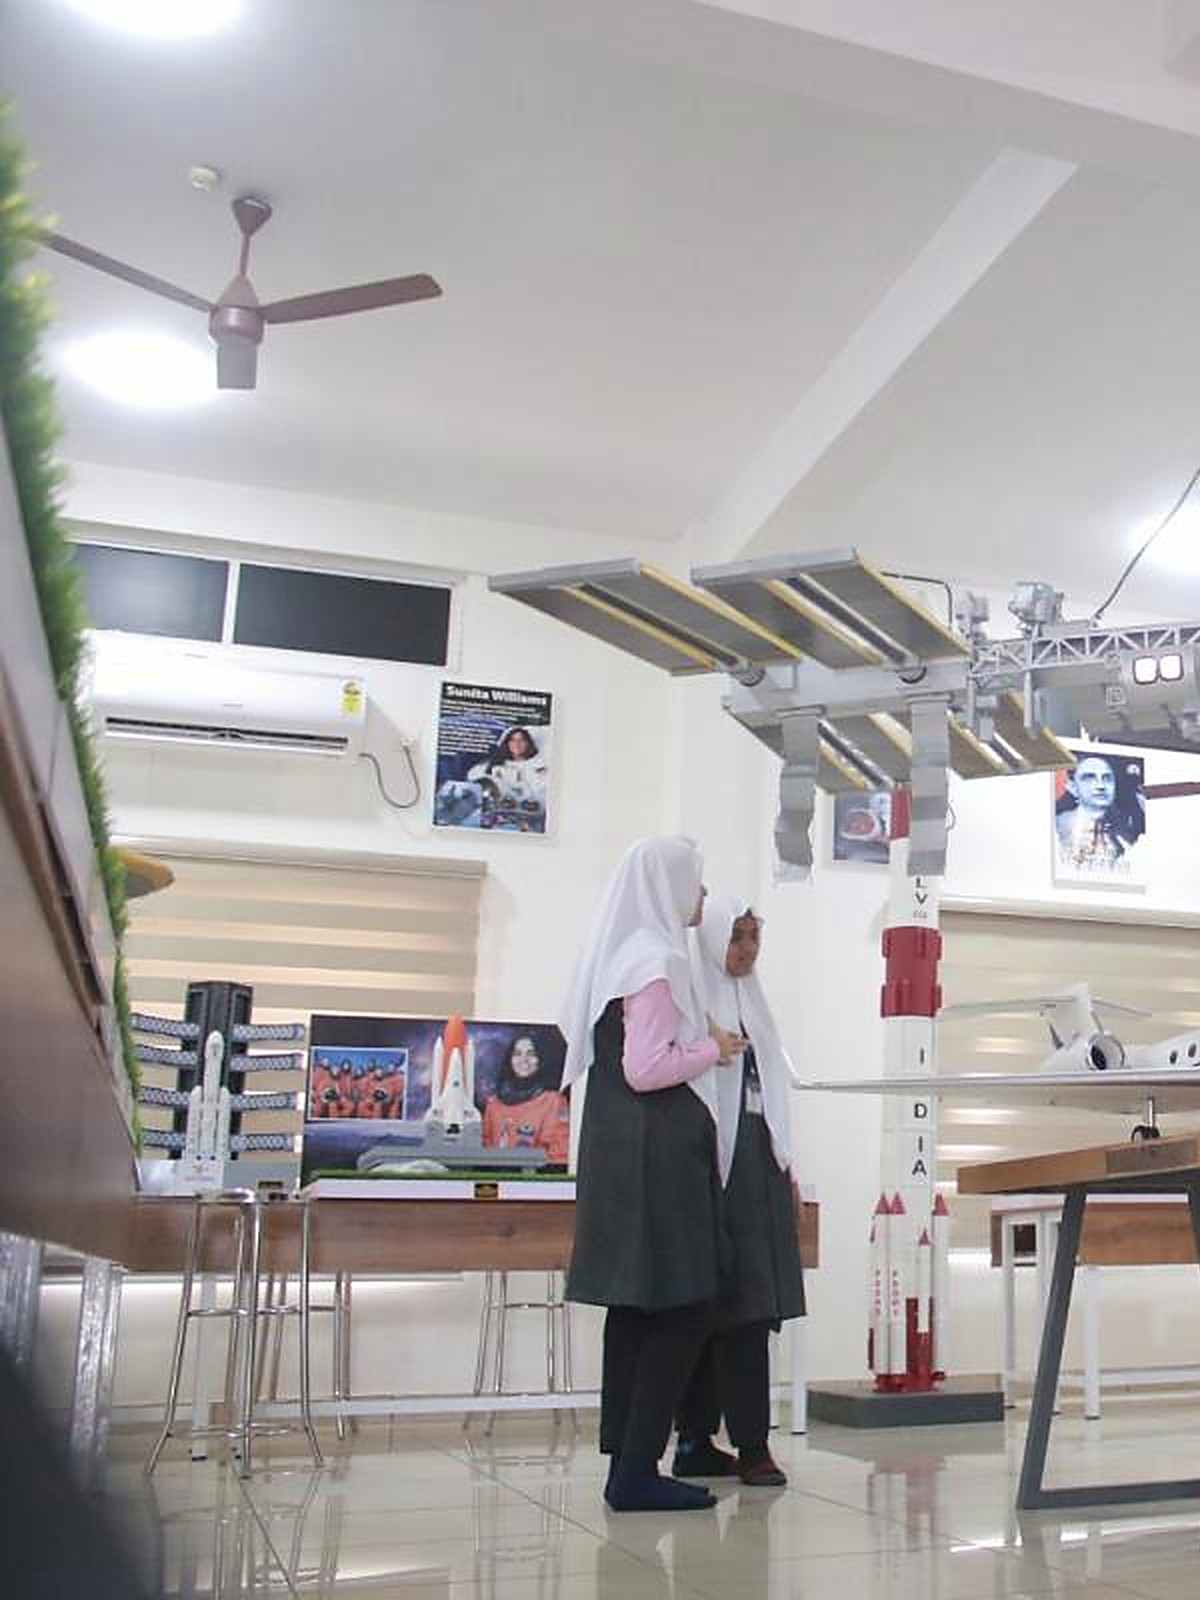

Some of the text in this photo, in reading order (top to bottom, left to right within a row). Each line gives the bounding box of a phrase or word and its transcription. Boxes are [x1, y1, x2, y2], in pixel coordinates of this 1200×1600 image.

[445, 685, 548, 706] Sunita Williams
[911, 1047, 929, 1177] IDIA
